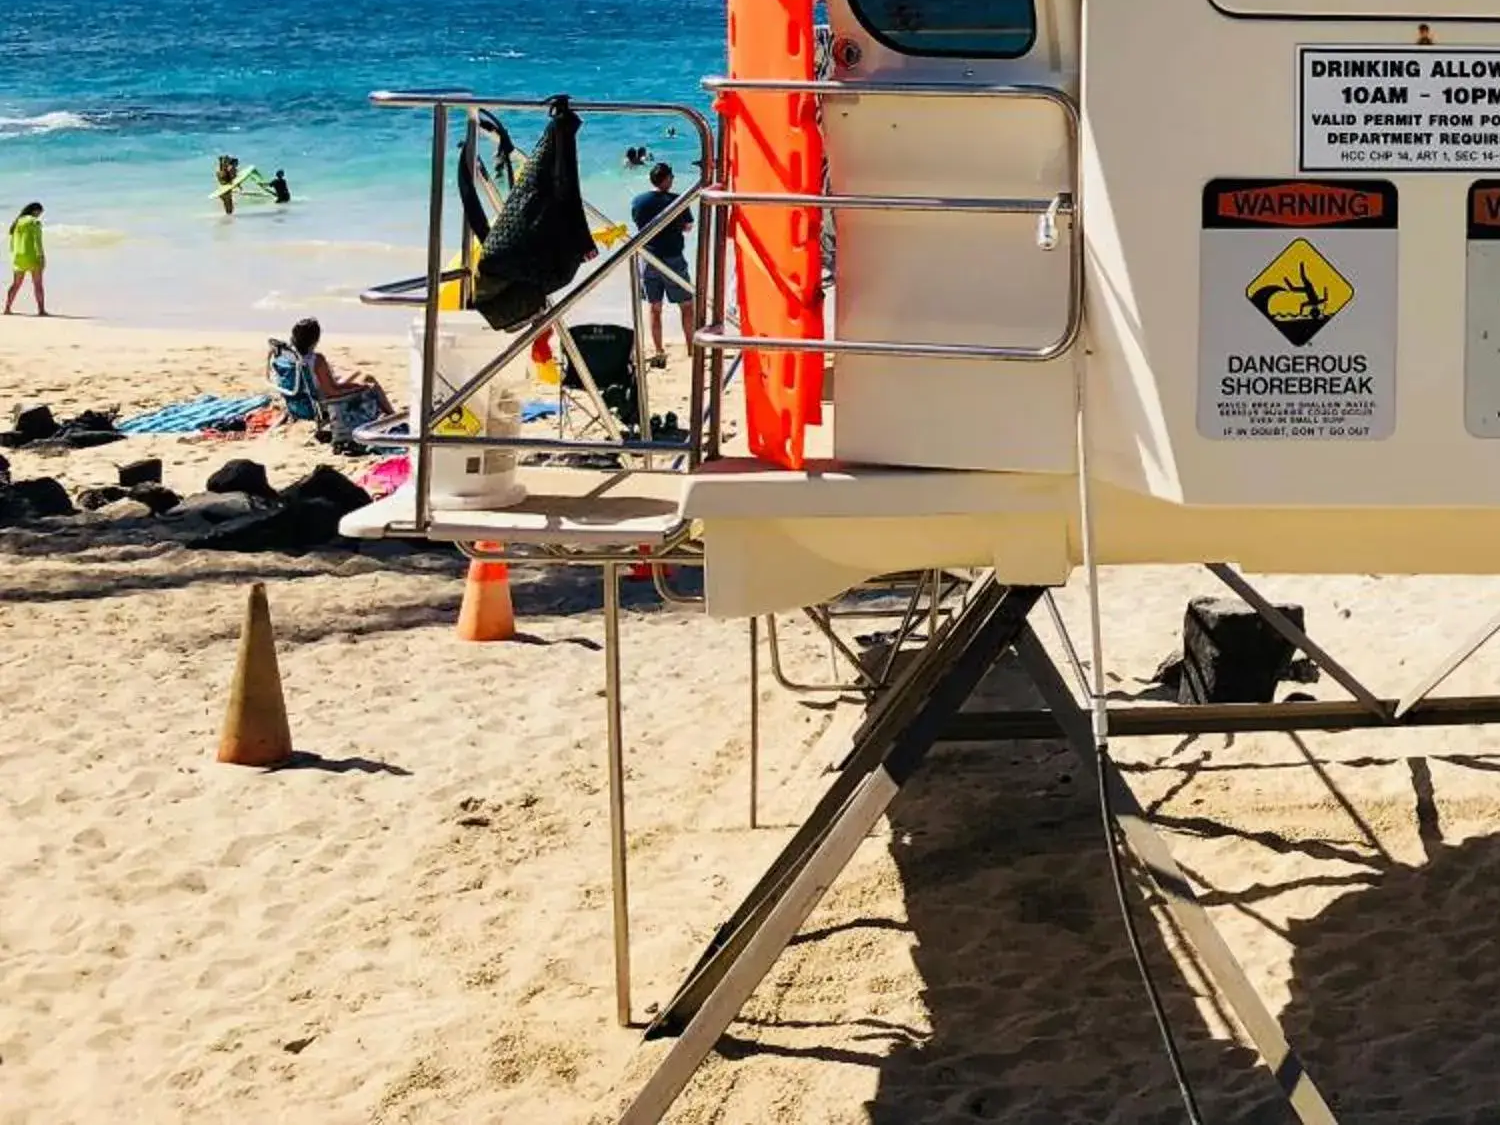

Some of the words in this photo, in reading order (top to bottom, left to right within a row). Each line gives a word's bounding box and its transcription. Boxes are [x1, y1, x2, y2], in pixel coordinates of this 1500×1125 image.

[1311, 60, 1421, 78] DRINKING
[1341, 86, 1408, 104] 10AM
[1311, 114, 1357, 126] VALID
[1363, 114, 1423, 126] PERMIT
[1429, 114, 1473, 126] FROM
[1327, 132, 1434, 145] DEPARTMENT
[1341, 150, 1366, 161] HCC
[1369, 150, 1393, 161] CHP
[1416, 150, 1439, 161] ART
[1454, 150, 1479, 162] SEC
[1232, 192, 1370, 217] WARNING
[1227, 355, 1367, 374] DANGEROUS
[1221, 376, 1373, 396] SHOREBREAK
[1291, 427, 1325, 436] DONT
[1329, 427, 1345, 436] GO
[1347, 427, 1370, 436] OUT
